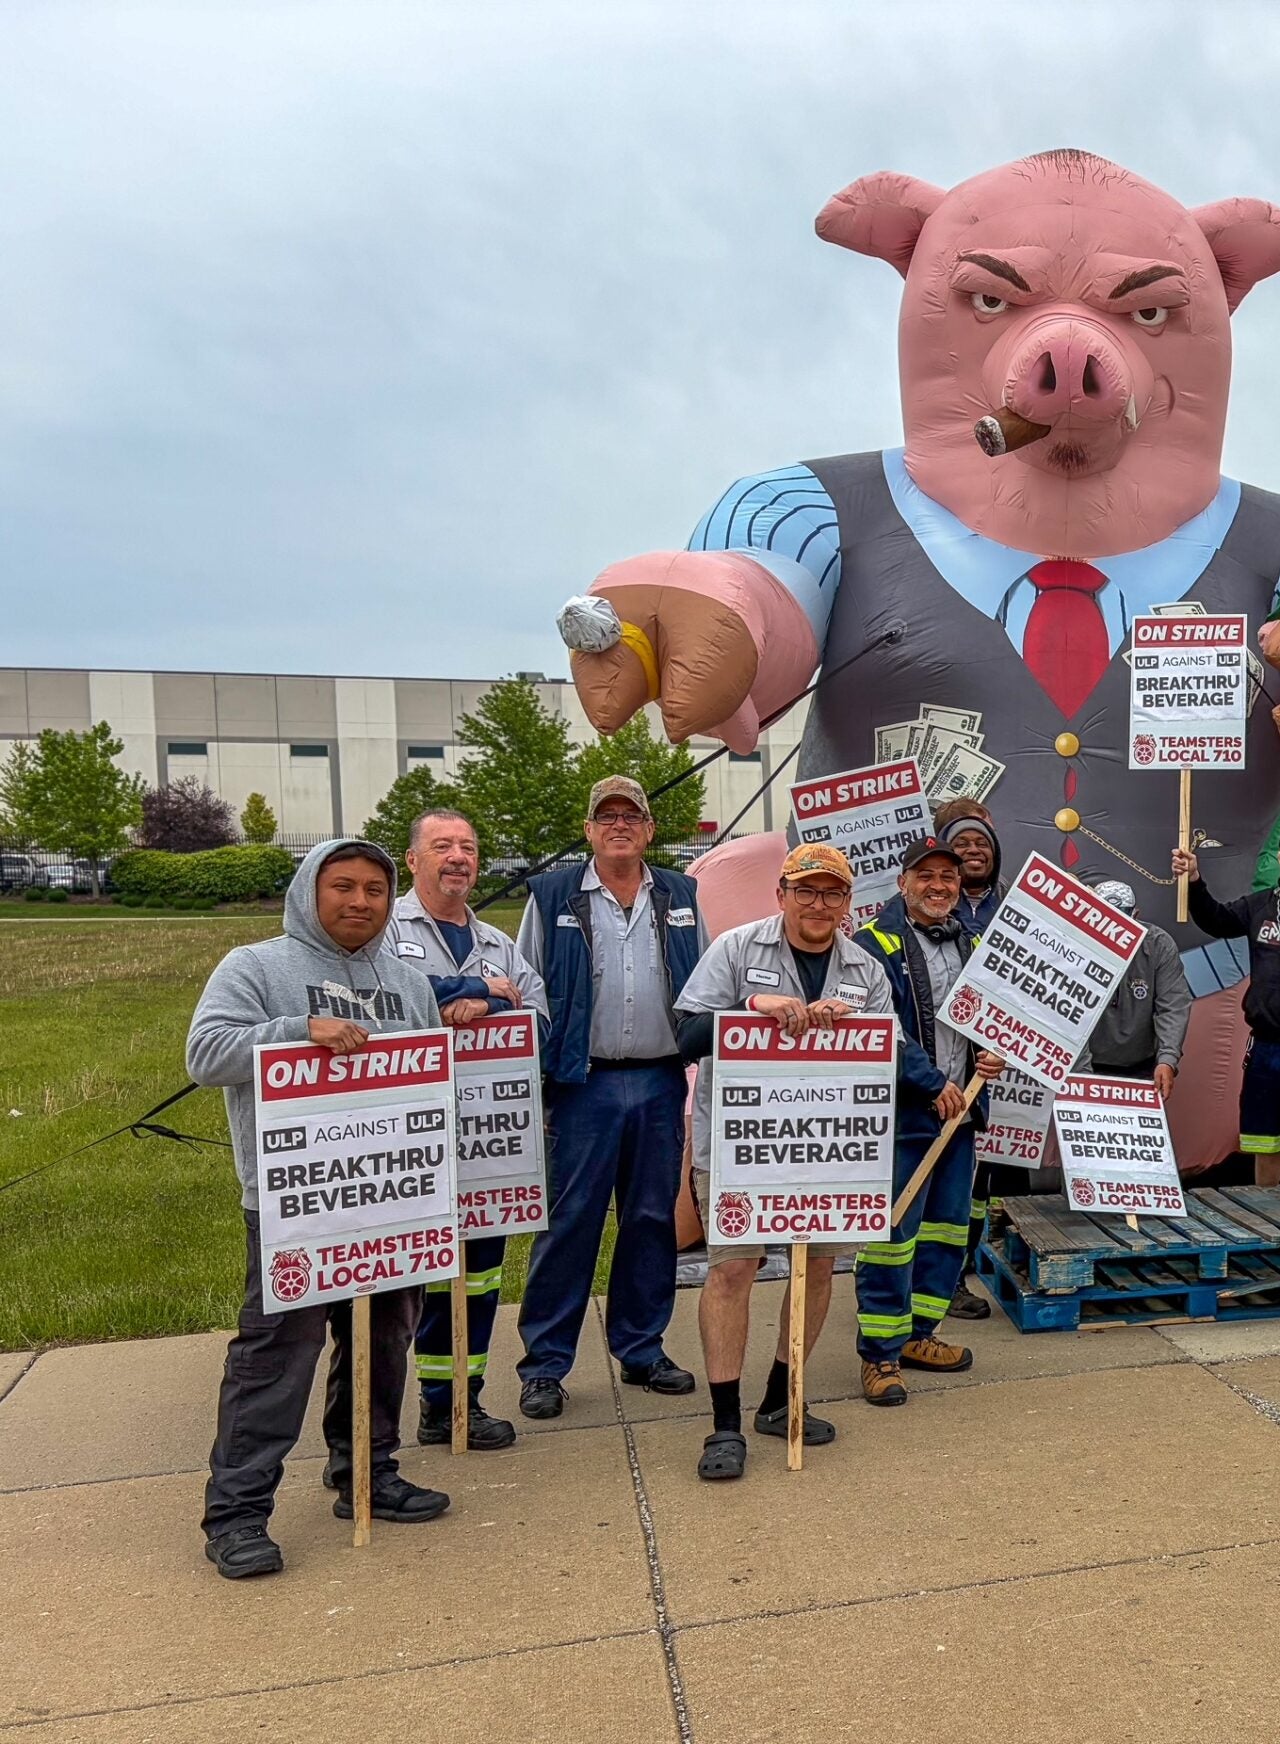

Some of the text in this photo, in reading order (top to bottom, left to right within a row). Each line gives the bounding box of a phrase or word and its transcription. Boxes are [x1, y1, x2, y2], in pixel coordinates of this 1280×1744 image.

[1138, 624, 1240, 641] ON STRIKE
[1137, 655, 1239, 667] ULP AGAINST ULP
[1136, 675, 1240, 691] BREAKTHRU
[1142, 692, 1234, 708] BEVERAGE
[1159, 736, 1242, 748] TEAMSTERS
[1159, 750, 1242, 762] LOCAL 710
[798, 787, 831, 812] ON
[836, 769, 913, 802] STRIKE
[803, 807, 921, 843] ULP AGAINST ULP
[1027, 869, 1137, 950] ON STRIKE
[1003, 909, 1111, 985] ULP AGAINST ULP
[986, 929, 1101, 1010] BREAKTHRU
[983, 952, 1084, 1026] BEVERAGE
[453, 1025, 527, 1052] RIKE
[723, 1027, 888, 1051] ON STRIKE
[985, 1002, 1073, 1066] TEAMSTERS
[973, 1016, 1028, 1063] LOCAL
[1031, 1053, 1064, 1081] 710
[266, 1046, 443, 1088] ON STRIKE
[495, 1082, 528, 1098] ULP
[725, 1087, 888, 1104] ULP AGAINST ULP
[1059, 1083, 1155, 1103] ON STRIKE
[724, 1116, 889, 1140] BREAKTHRU
[1059, 1111, 1161, 1128] ULP AGAINST ULP
[266, 1129, 304, 1152] ULP
[314, 1118, 399, 1144] AGAINST
[409, 1112, 443, 1131] ULP
[987, 1124, 1044, 1144] MSTERS
[1061, 1128, 1165, 1148] BREAKTHRU
[734, 1141, 879, 1166] BEVERAGE
[975, 1137, 1040, 1159] CAL 710
[1071, 1144, 1163, 1163] BEVERAGE
[267, 1143, 444, 1192] BREAKTHRU
[280, 1173, 435, 1219] BEVERAGE
[457, 1184, 542, 1209] MSTERS
[1096, 1181, 1180, 1197] TEAMSTERS
[757, 1193, 887, 1212] TEAMSTERS
[1099, 1194, 1182, 1210] LOCAL 710
[499, 1203, 543, 1225] 710
[756, 1213, 886, 1233] LOCAL 710
[316, 1226, 454, 1266] TEAMSTERS
[317, 1248, 454, 1292] LOCAL 710
